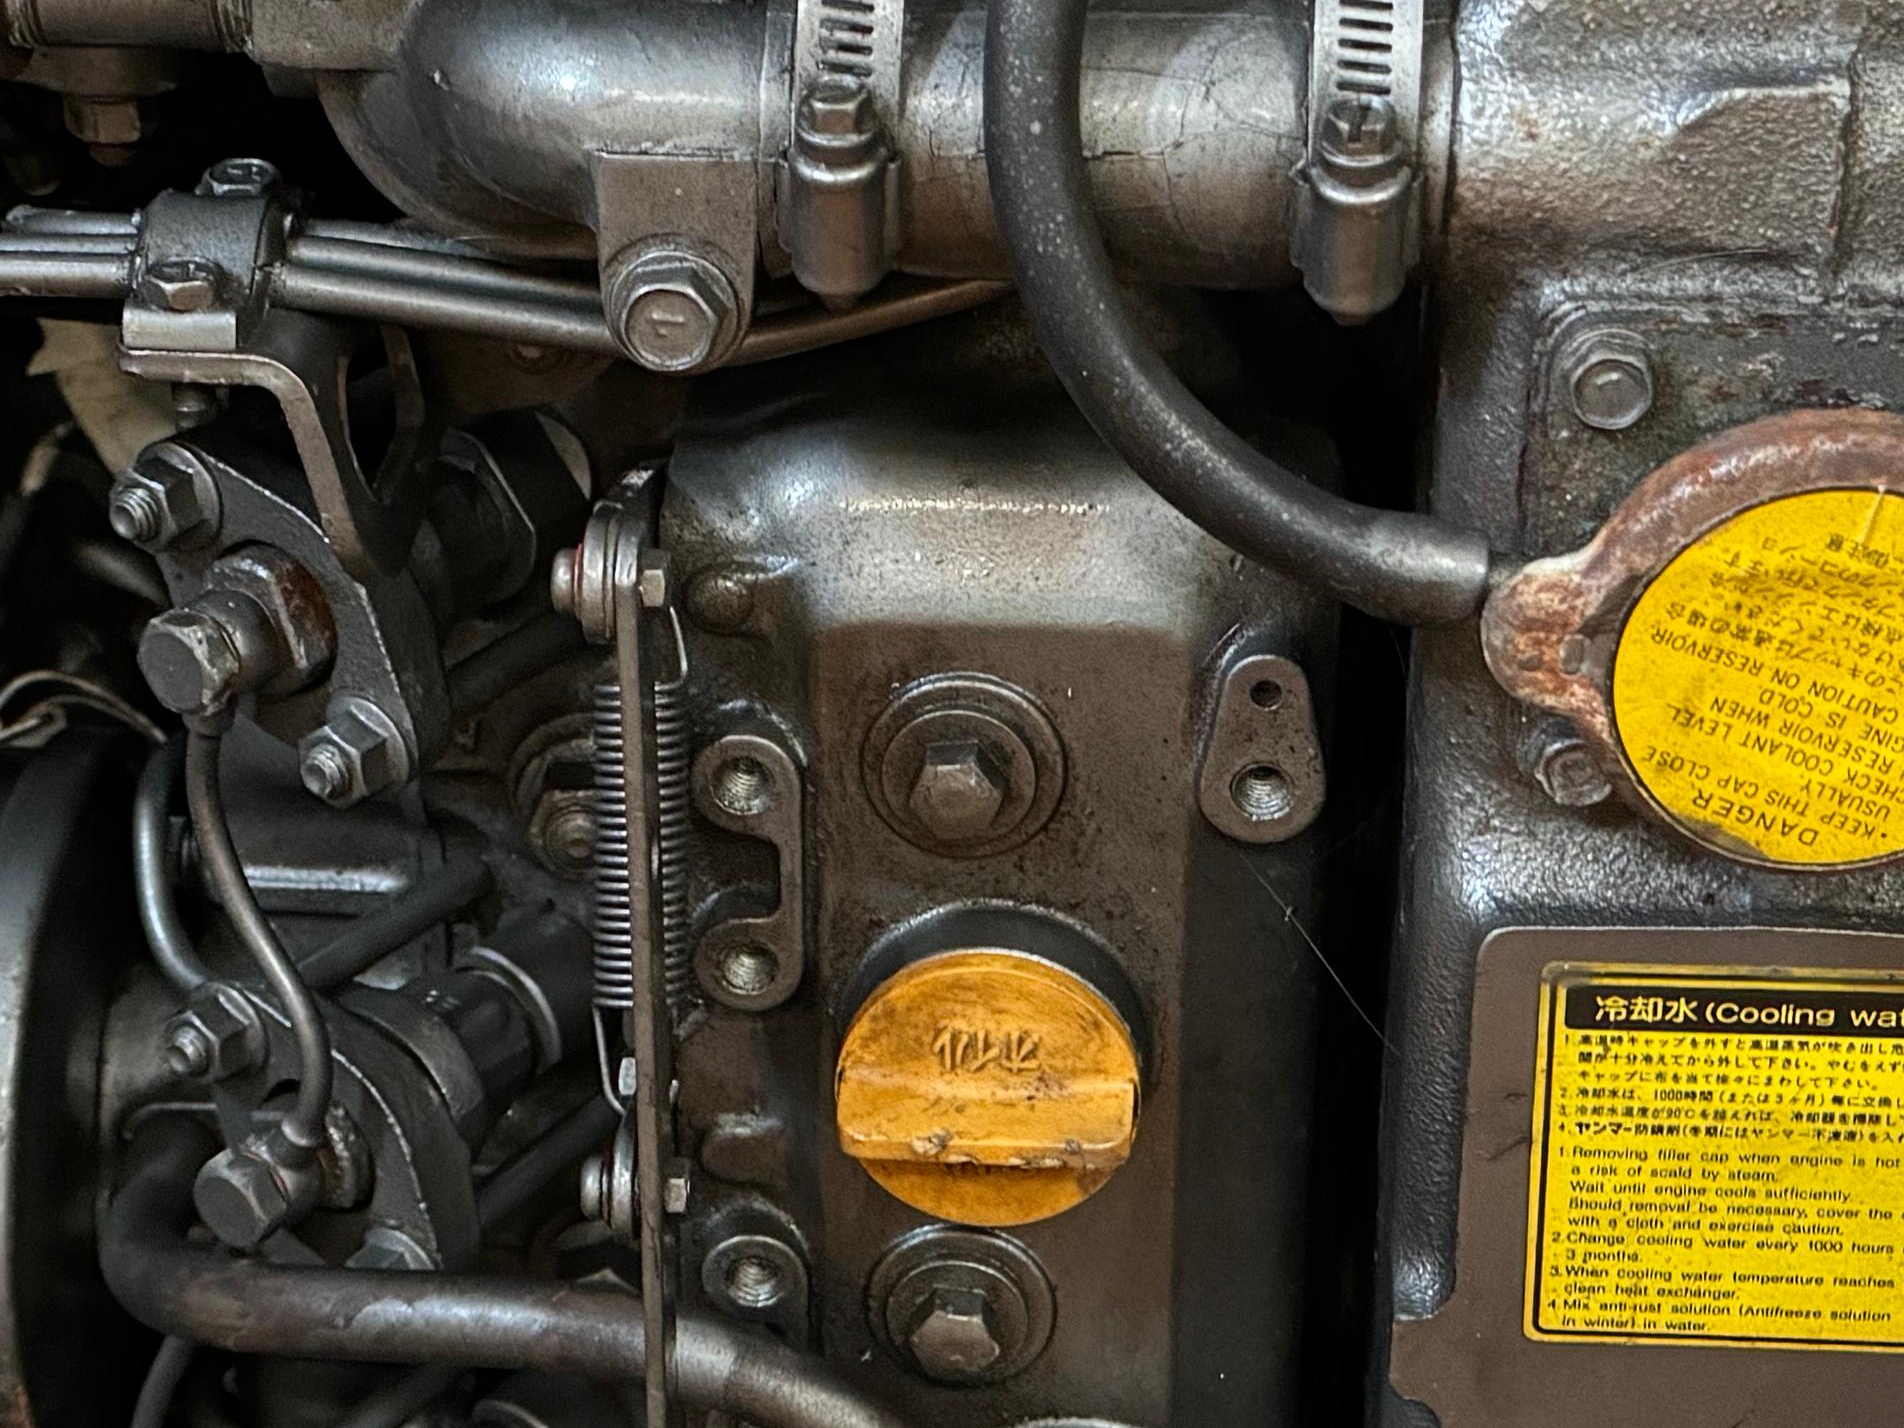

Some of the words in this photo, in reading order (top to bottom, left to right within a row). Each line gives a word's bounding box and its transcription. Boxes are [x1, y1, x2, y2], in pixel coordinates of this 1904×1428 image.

[1771, 667, 1801, 689] ON
[1710, 697, 1770, 730] WHEN
[1807, 681, 1899, 723] CAUTION
[1667, 704, 1732, 739] LEVEL
[1824, 711, 1847, 730] IS
[1737, 731, 1834, 776] COOLANT
[1780, 719, 1893, 774] RESERVOIR
[1640, 744, 1712, 781] CLOSE
[1717, 773, 1758, 798] CAP
[1764, 789, 1810, 817] THIS
[1820, 812, 1876, 839] KEEP
[932, 1026, 1040, 1074] オイル
[1572, 1146, 1648, 1161] Removing
[1657, 1148, 1690, 1161] filler
[1700, 1151, 1729, 1164] cap
[1738, 1152, 1780, 1164] when
[1789, 1154, 1843, 1168] engine
[1852, 1155, 1866, 1167] is
[1875, 1156, 1900, 1168] hot
[1570, 1165, 1580, 1175] a
[1589, 1164, 1617, 1176] risk
[1626, 1166, 1642, 1177] of
[1650, 1166, 1692, 1178] scald
[1700, 1168, 1719, 1182] by
[1569, 1180, 1605, 1194] Wait
[1613, 1182, 1645, 1194] until
[1653, 1184, 1706, 1198] engine
[1714, 1185, 1756, 1198] cools
[1568, 1196, 1622, 1211] Should
[1629, 1199, 1690, 1213] removal
[1698, 1201, 1718, 1214] be
[1815, 1208, 1861, 1219] cover
[1868, 1208, 1893, 1220] the
[1567, 1215, 1599, 1227] with
[1625, 1216, 1664, 1229] cloth
[1672, 1218, 1701, 1230] and
[1708, 1221, 1774, 1233] exercise
[1565, 1248, 1576, 1260] 3
[1566, 1231, 1625, 1247] Change
[1635, 1234, 1693, 1249] cooling
[1703, 1237, 1746, 1248] water
[1754, 1239, 1799, 1253] every
[1808, 1240, 1843, 1252] 1000
[1850, 1241, 1894, 1254] hours
[1565, 1265, 1609, 1278] When
[1616, 1267, 1672, 1282] cooling
[1680, 1271, 1723, 1282] water
[1731, 1271, 1824, 1288] temperature
[1832, 1276, 1895, 1289] reaches
[1563, 1282, 1605, 1297] clean
[1614, 1284, 1649, 1297] heat
[1561, 1314, 1576, 1326] in
[1642, 1317, 1657, 1329] in
[1562, 1298, 1590, 1310] Mix
[1670, 1302, 1730, 1316] solution
[1829, 1309, 1891, 1323] solution
